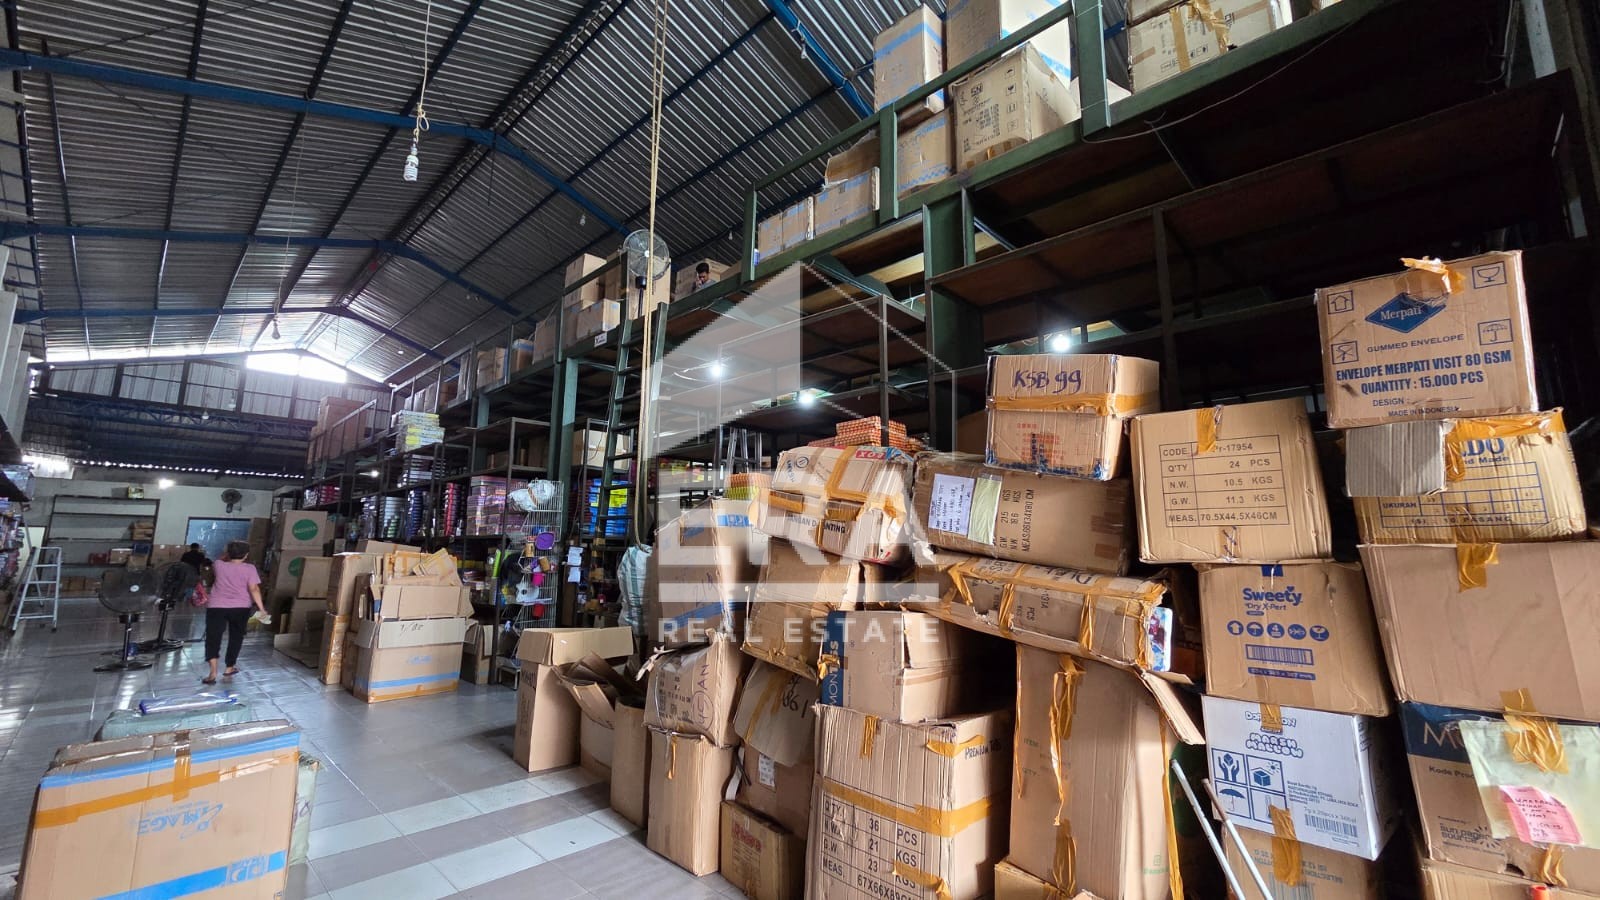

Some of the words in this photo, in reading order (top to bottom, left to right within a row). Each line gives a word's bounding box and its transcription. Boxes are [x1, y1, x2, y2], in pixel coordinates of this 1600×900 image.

[1380, 305, 1423, 321] Merpati
[1367, 341, 1408, 353] GUMMED
[1410, 333, 1465, 347] ENVELOPE
[1336, 363, 1383, 381] ENVELOPE
[1384, 360, 1430, 376] MERPATI
[1432, 356, 1462, 371] VISIT
[1465, 353, 1481, 366] 80
[1484, 350, 1512, 364] GSM
[1361, 378, 1411, 395] QUANTITY
[1419, 374, 1457, 389] 15.000
[1460, 370, 1484, 384] PCS
[1372, 397, 1405, 407] DESIGN
[1388, 409, 1408, 417] MADE
[1410, 408, 1417, 416] IN
[1462, 438, 1505, 456] DO
[1168, 464, 1188, 473] Q'TY
[1229, 461, 1241, 469] 24
[1250, 458, 1271, 467] PCS
[1224, 478, 1244, 487] 10.5
[1252, 476, 1273, 485] KGS
[1254, 493, 1275, 503] KGS
[1243, 587, 1302, 606] Sweety
[1429, 765, 1453, 776] Kode
[869, 818, 880, 830] 36
[896, 828, 918, 846] PCS
[869, 838, 879, 852] 21
[896, 848, 917, 867] KGS
[868, 858, 878, 872] 23
